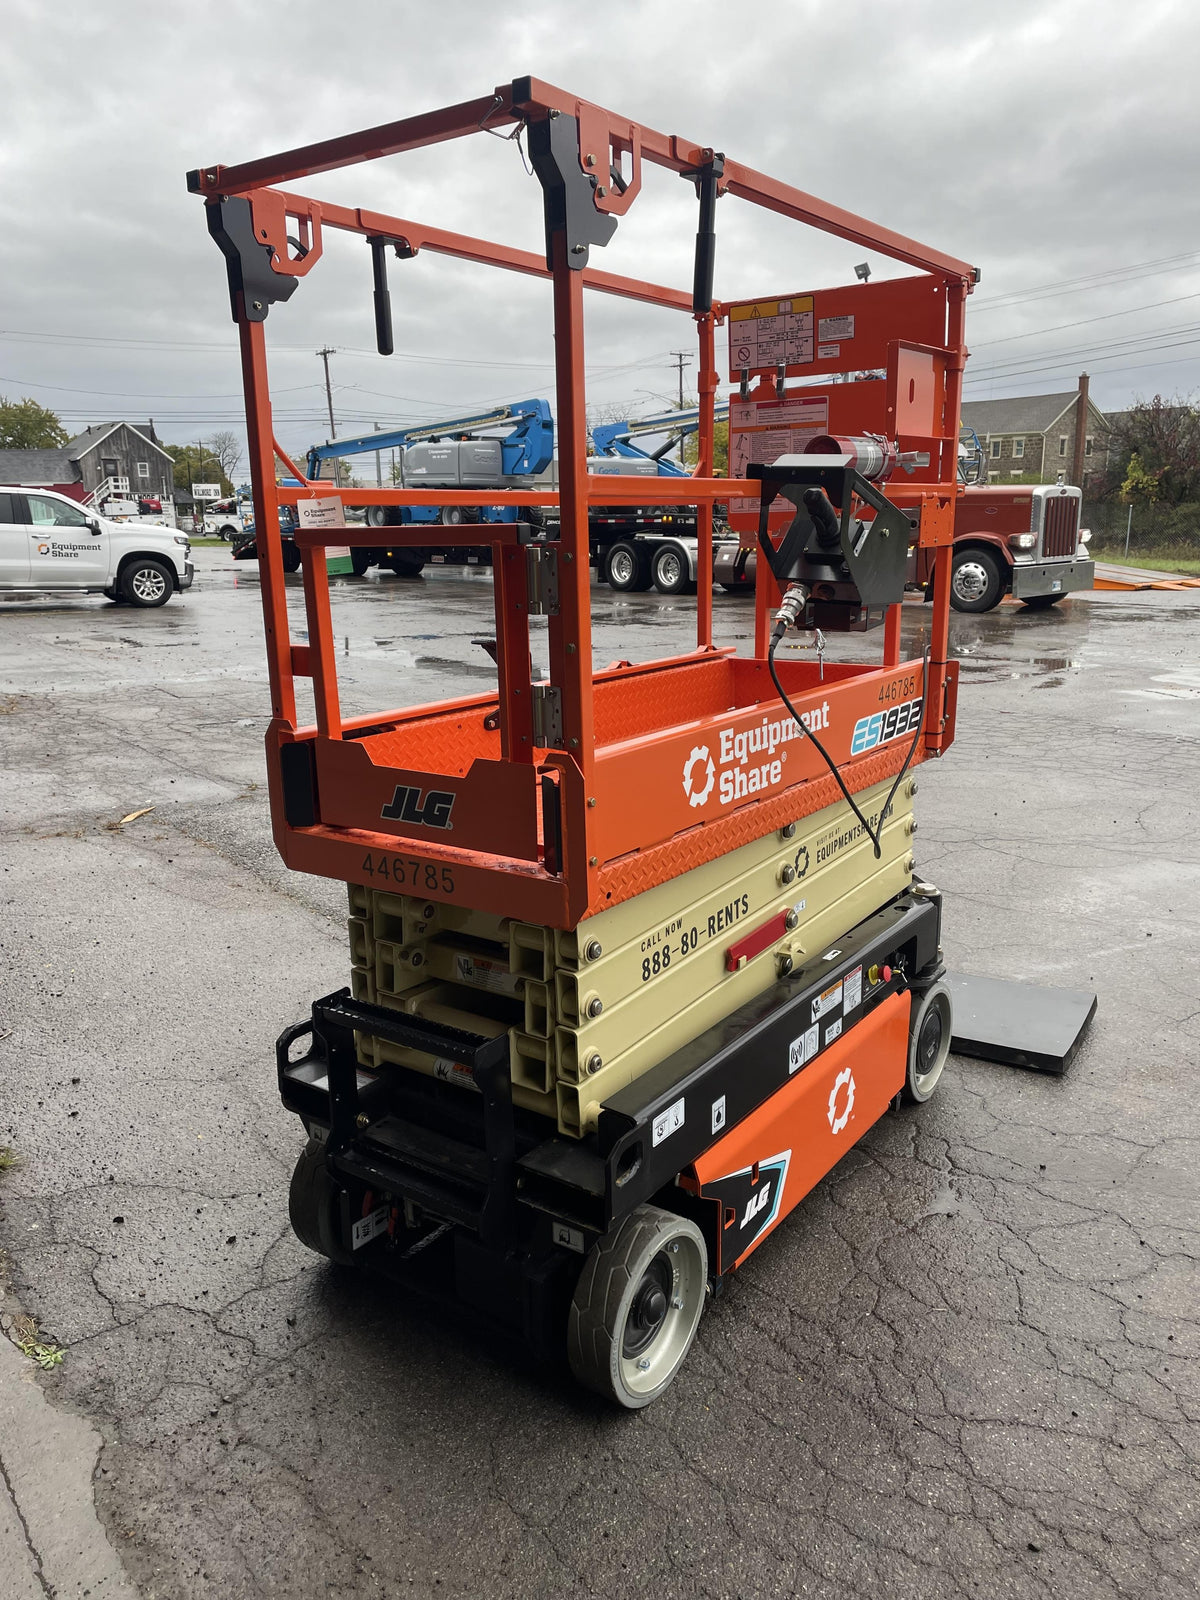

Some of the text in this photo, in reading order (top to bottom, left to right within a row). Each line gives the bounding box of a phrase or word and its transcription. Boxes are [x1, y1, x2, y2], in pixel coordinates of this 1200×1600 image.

[51, 542, 102, 551] Equipment
[878, 676, 915, 703] 446785
[719, 701, 830, 765] Equipment
[851, 697, 923, 756] ES1932
[719, 759, 782, 805] Share
[381, 785, 456, 829] JLG
[362, 854, 455, 894] 446785
[641, 919, 683, 952] CALL NOW
[642, 893, 749, 981] 888-80-RENTS
[740, 1181, 771, 1230] JLG
